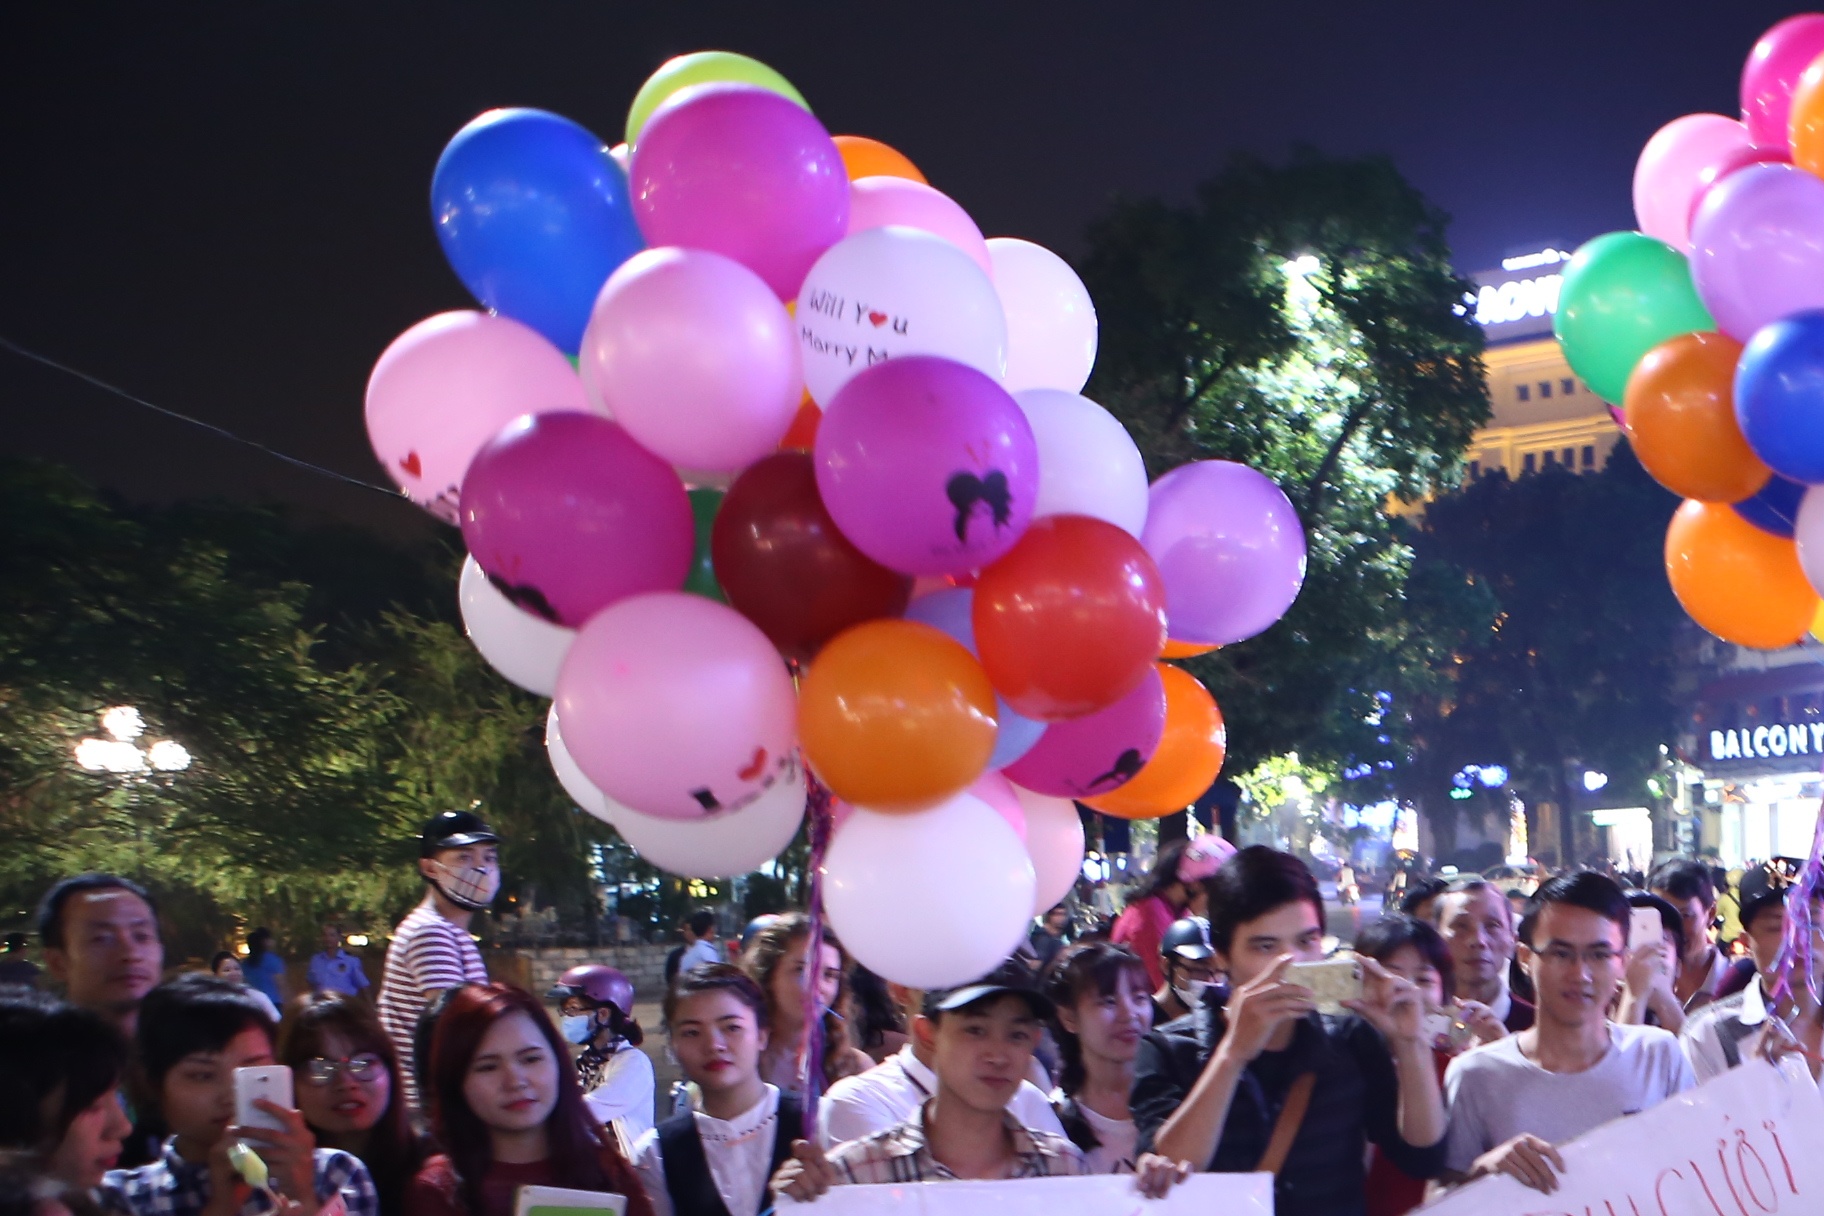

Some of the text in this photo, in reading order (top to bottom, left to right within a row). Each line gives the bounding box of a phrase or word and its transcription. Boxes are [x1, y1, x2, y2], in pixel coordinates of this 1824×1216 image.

[809, 288, 844, 320] Will
[802, 325, 890, 367] Marry M
